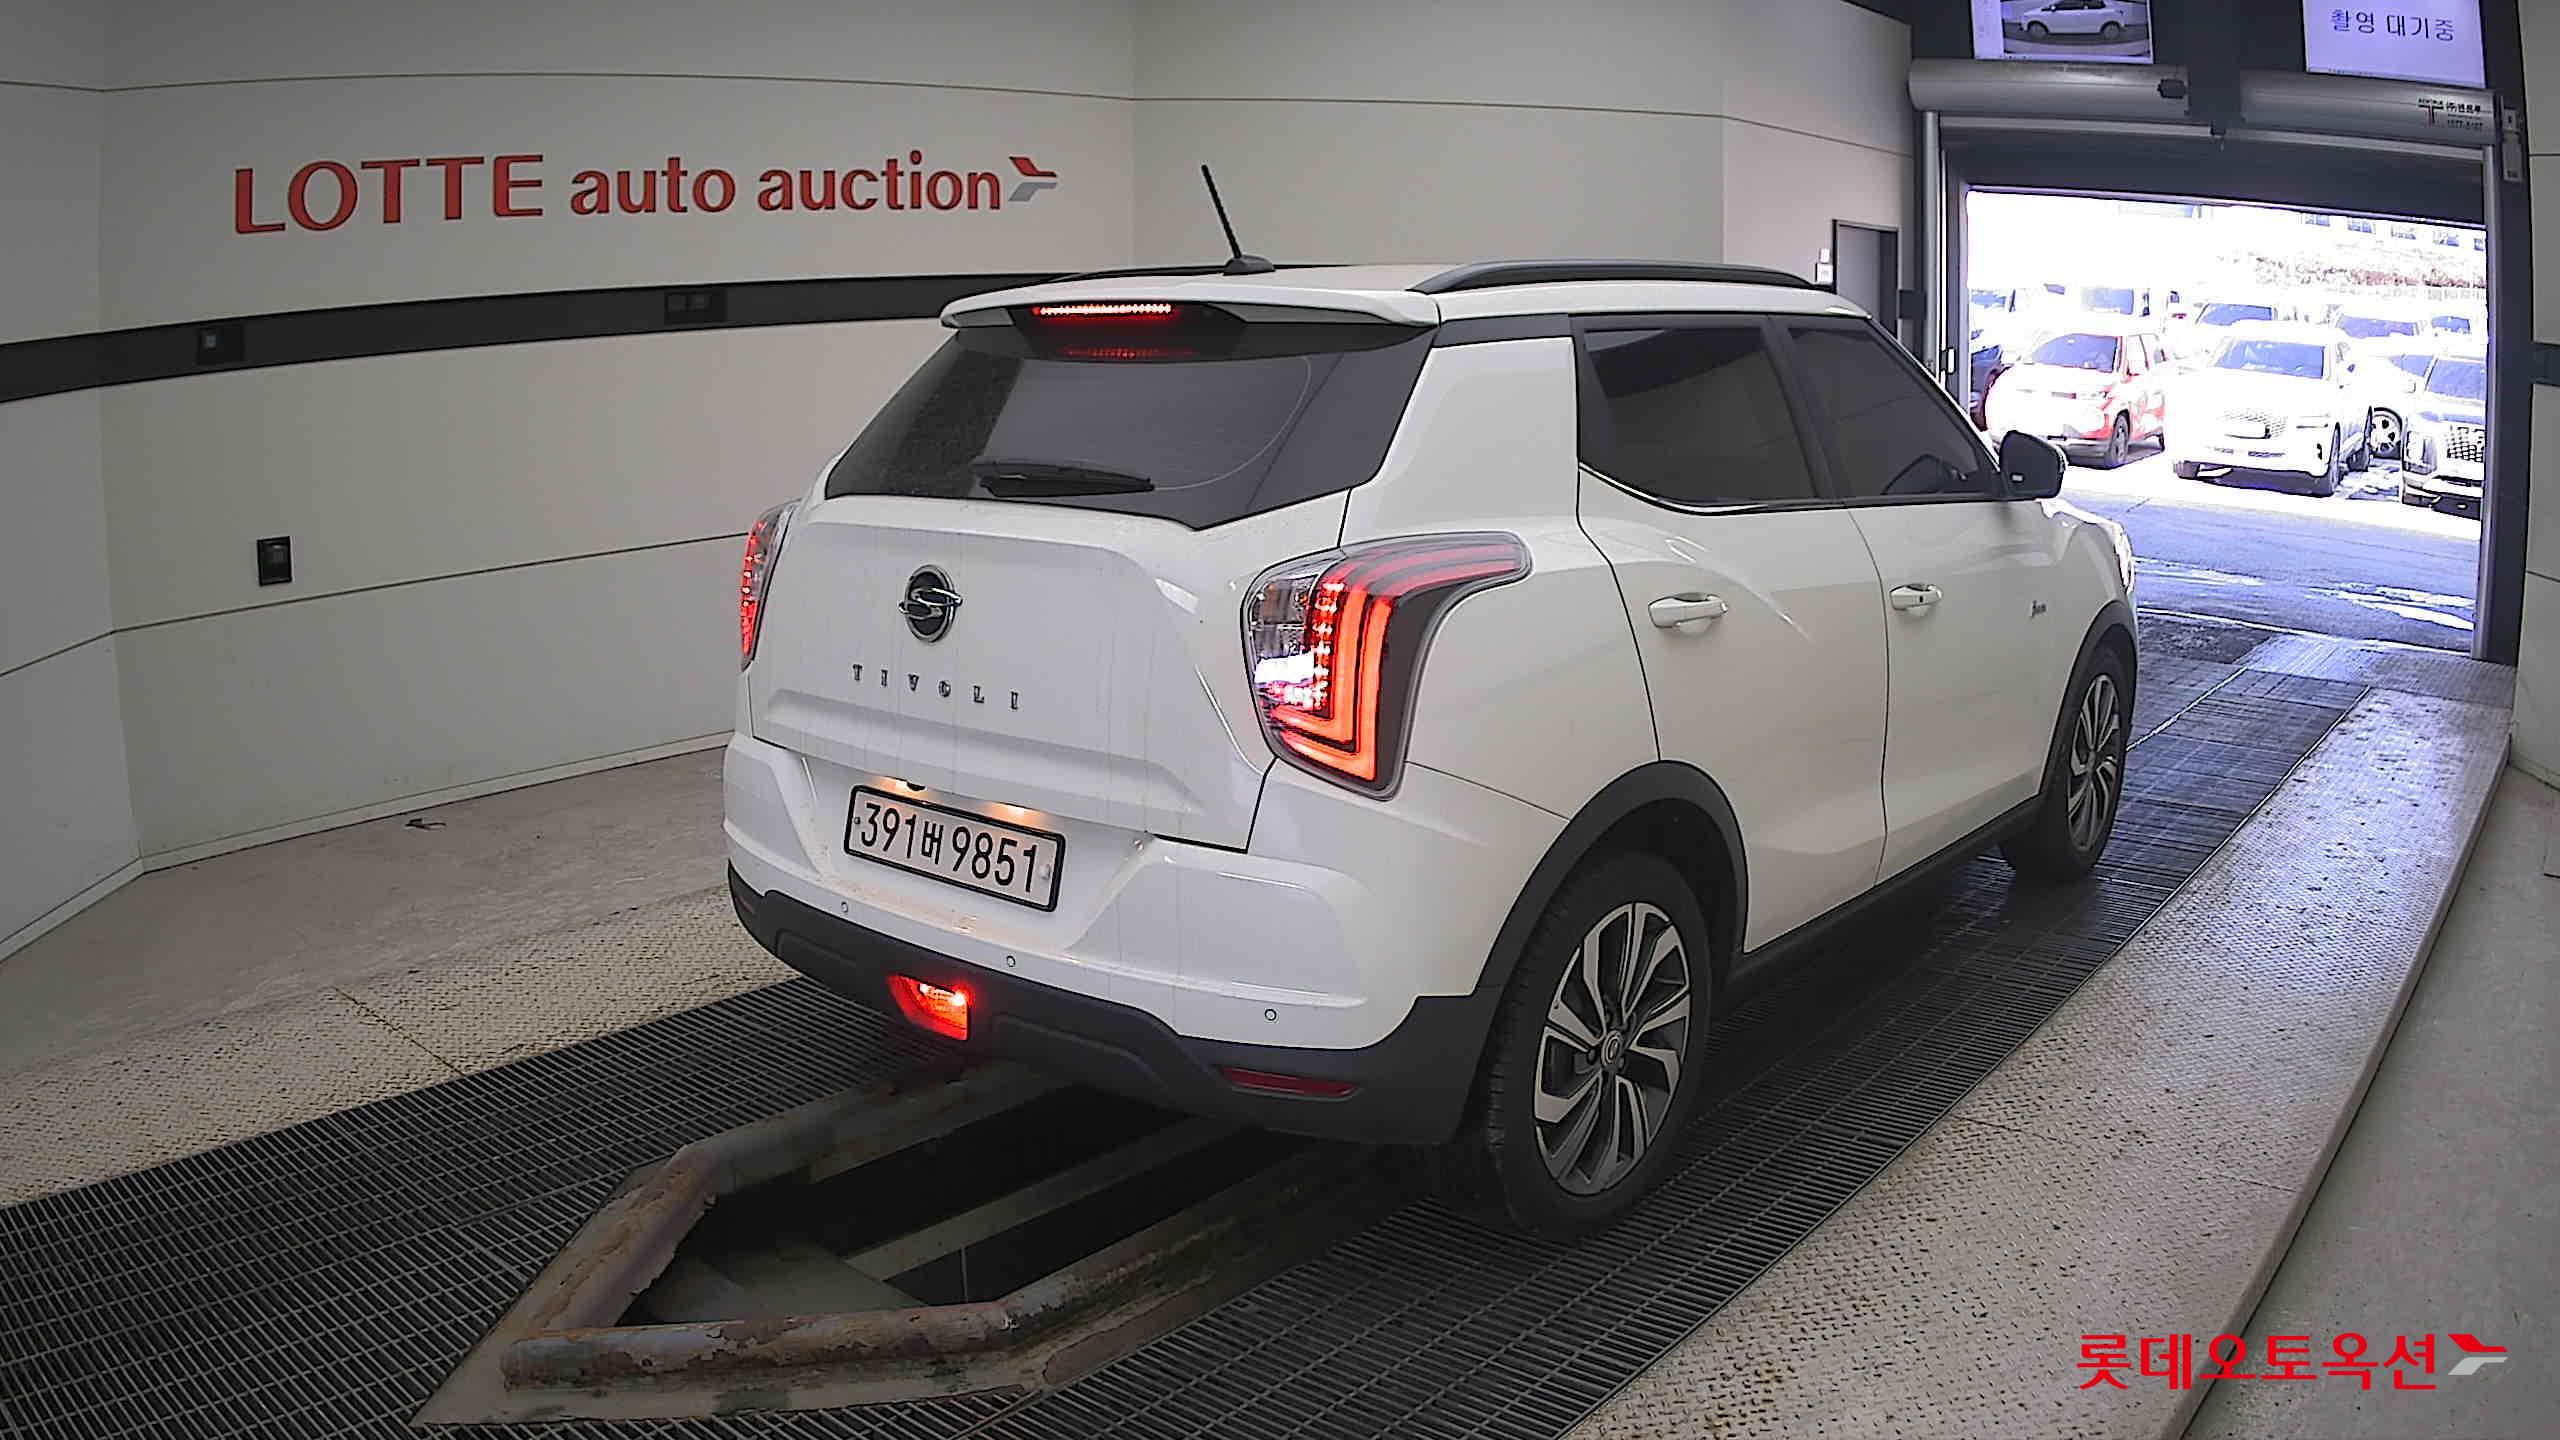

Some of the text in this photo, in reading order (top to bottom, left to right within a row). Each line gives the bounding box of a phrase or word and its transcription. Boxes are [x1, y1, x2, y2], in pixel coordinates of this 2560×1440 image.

[2386, 15, 2455, 42] 대기중
[234, 149, 1002, 235] LOTTE auto auction
[852, 664, 1020, 711] TIVOLI
[861, 802, 1038, 893] 391버9851
